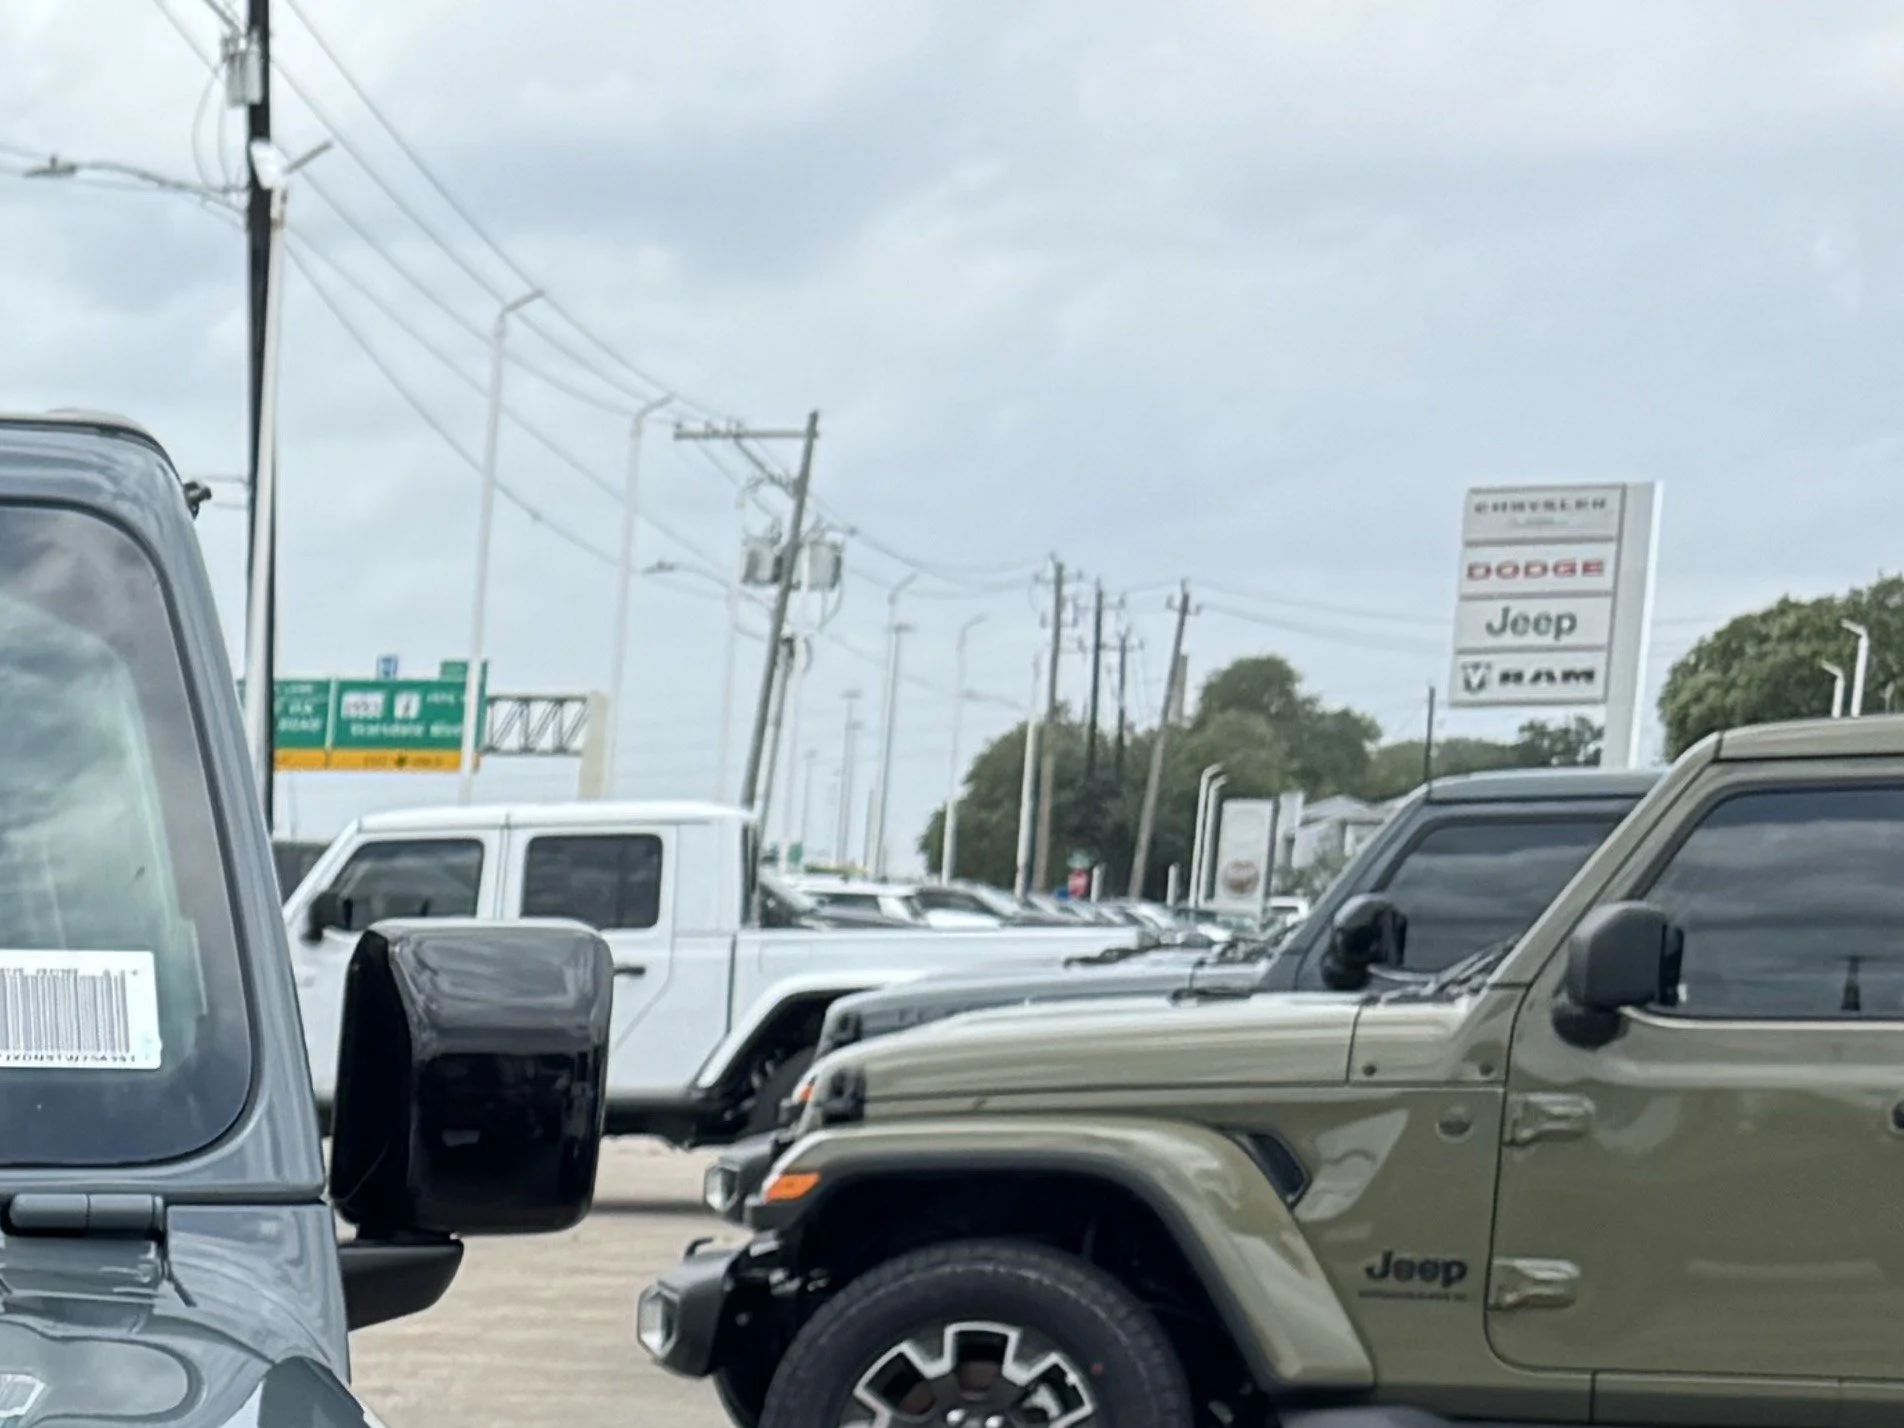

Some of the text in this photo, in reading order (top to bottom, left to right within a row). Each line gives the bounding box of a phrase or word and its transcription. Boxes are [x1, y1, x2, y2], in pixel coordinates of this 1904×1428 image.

[1467, 559, 1605, 580] DODGE
[1485, 606, 1578, 642] Jeep
[1498, 669, 1596, 686] RAM
[1364, 1249, 1469, 1289] Jeep
